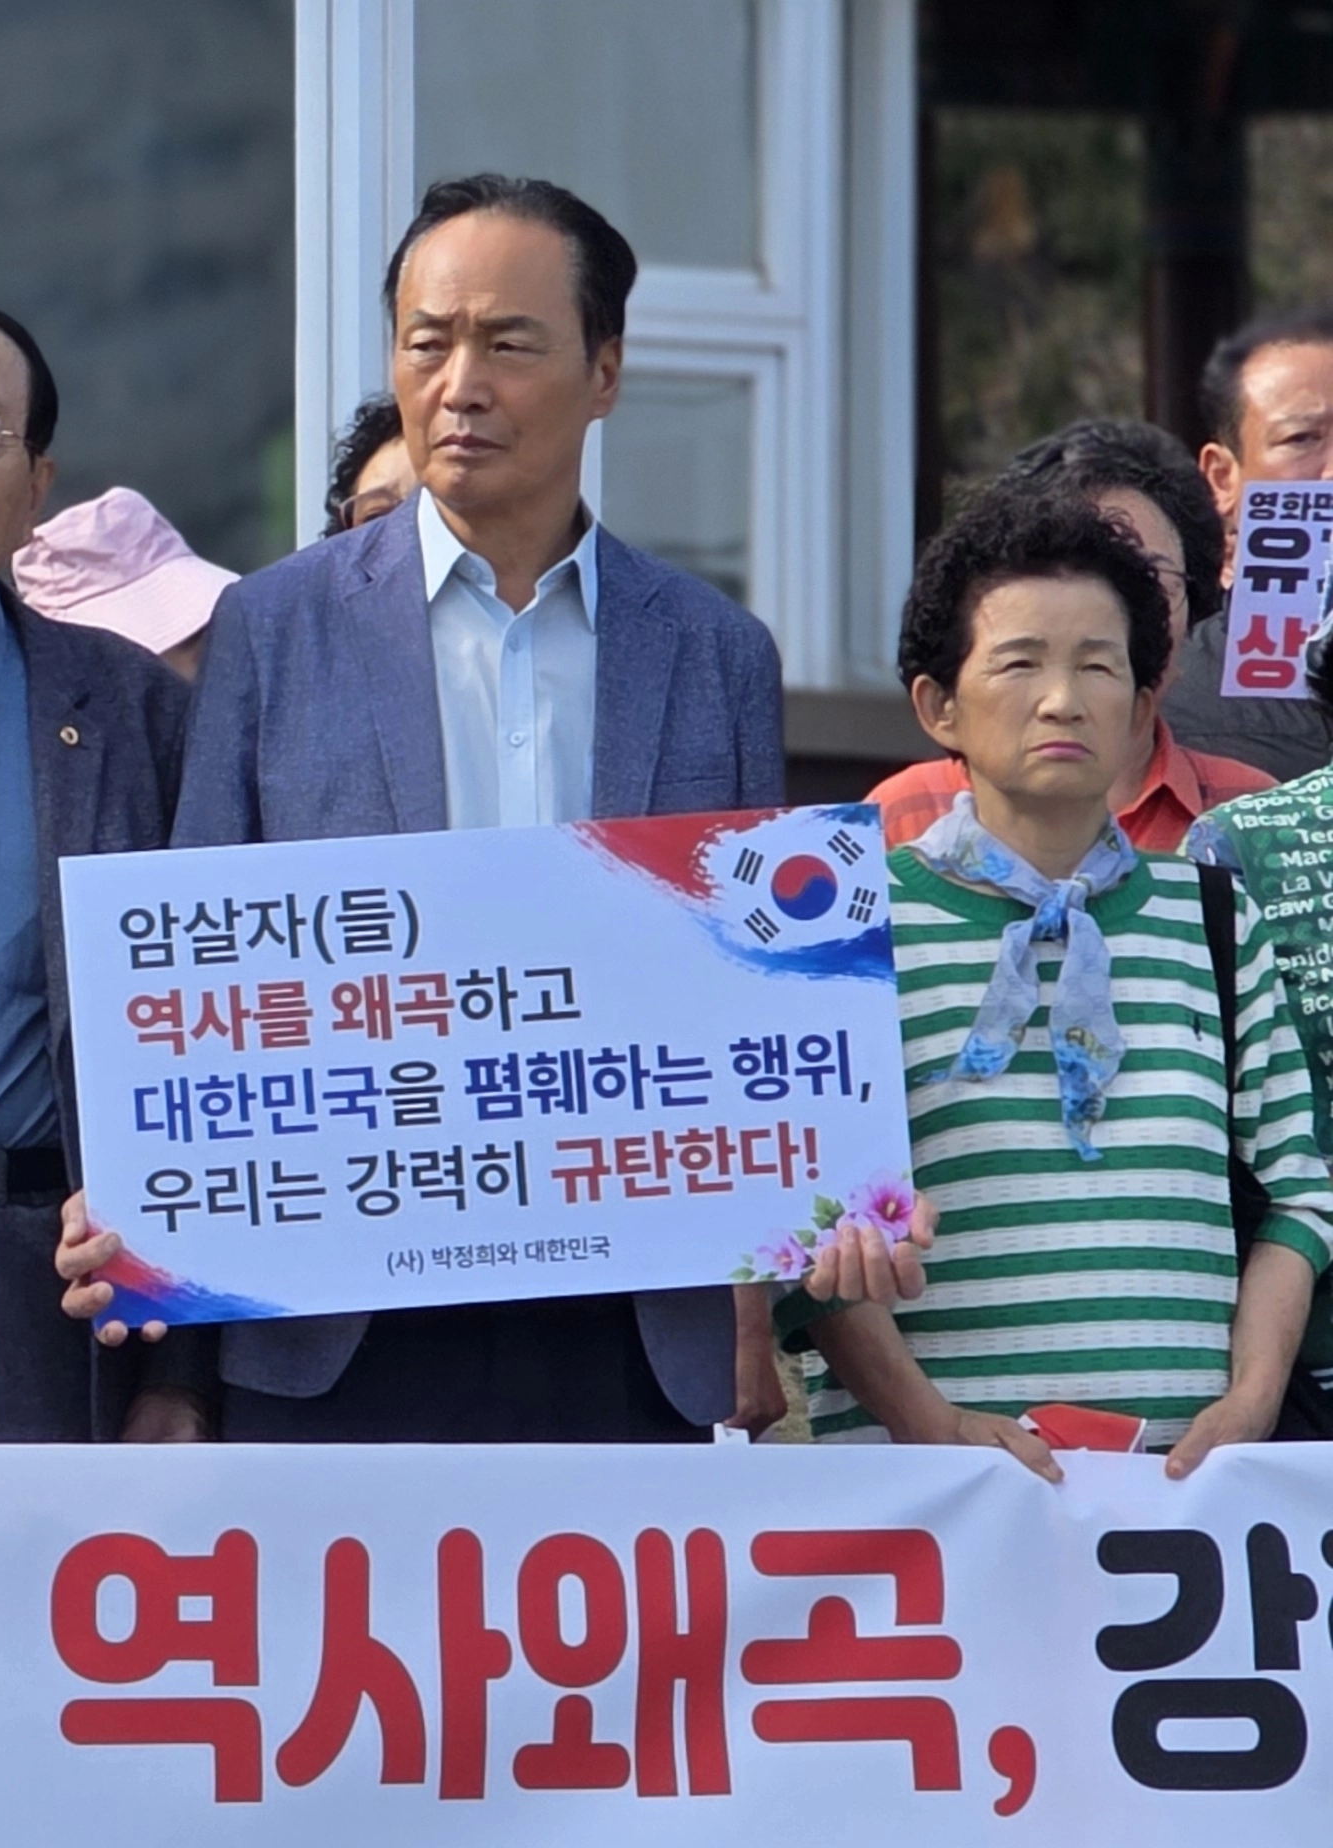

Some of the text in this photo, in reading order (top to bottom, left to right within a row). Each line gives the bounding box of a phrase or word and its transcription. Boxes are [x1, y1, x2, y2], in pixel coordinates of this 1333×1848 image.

[1242, 527, 1332, 594] 유
[1236, 615, 1320, 689] 상
[119, 888, 420, 969] 암살자(들)
[126, 966, 581, 1056] 역사를 왜곡하고
[134, 1030, 871, 1143] 대한민국을 폄훼하는 행위,
[140, 1121, 820, 1233] 우리는 강력히 규탄한다!
[387, 1236, 611, 1276] (사) 박정희와 대한민국
[50, 1527, 1037, 1817] 역사왜곡,
[1095, 1522, 1333, 1791] 강
